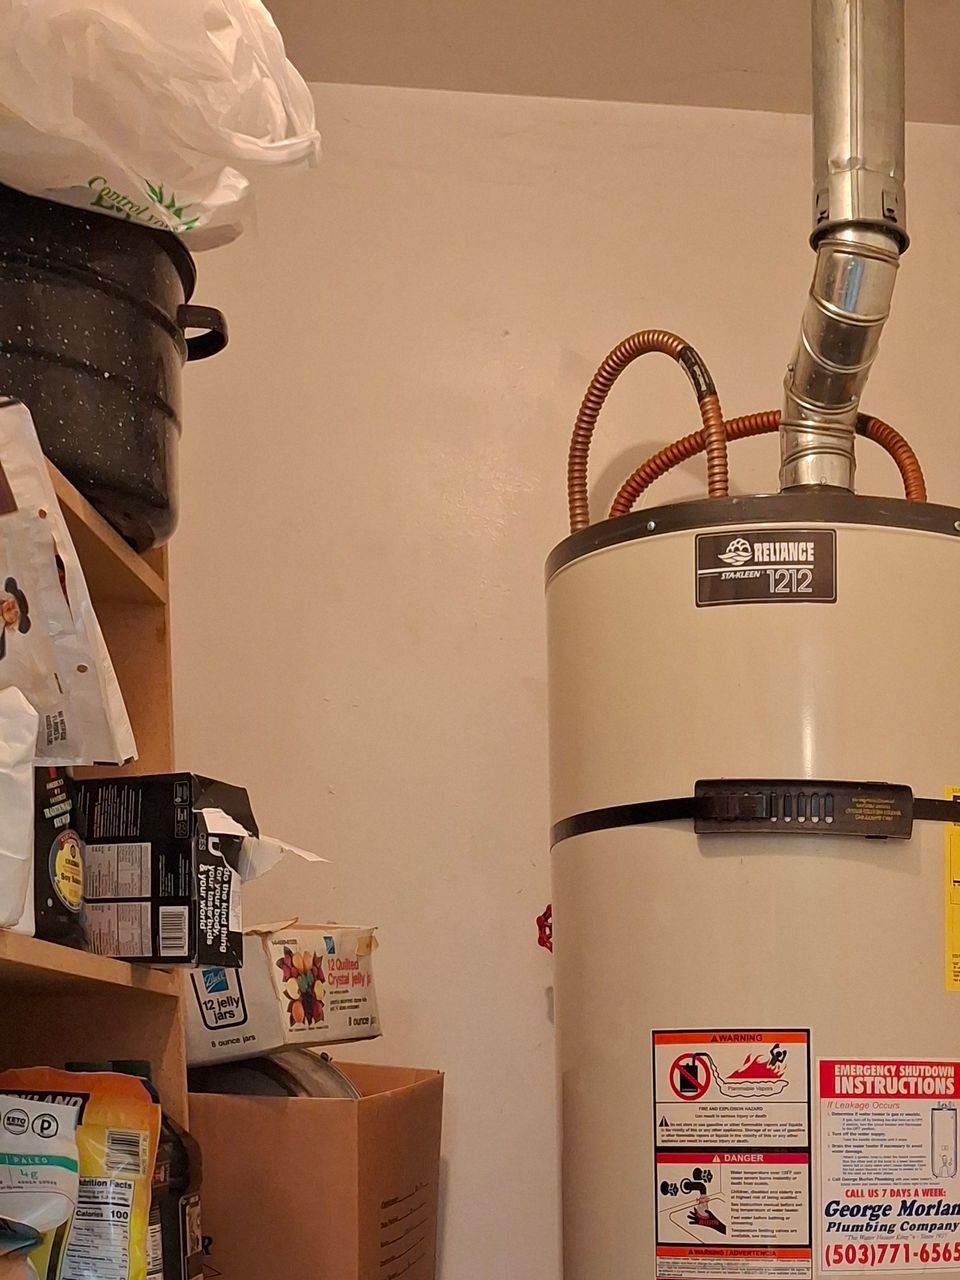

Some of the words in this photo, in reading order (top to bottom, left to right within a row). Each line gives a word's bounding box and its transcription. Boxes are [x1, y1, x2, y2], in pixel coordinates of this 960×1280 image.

[88, 176, 149, 215] Control
[753, 541, 815, 563] RELIANCE
[720, 570, 761, 580] STA-KLEEN
[766, 568, 813, 593] 1212
[199, 863, 208, 872] &
[216, 866, 224, 881] for
[222, 867, 232, 882] do
[208, 865, 216, 889] your
[198, 873, 207, 898] your
[221, 883, 229, 900] the
[214, 883, 222, 906] your
[199, 902, 207, 930] world
[220, 902, 229, 925] kind
[213, 908, 221, 937] body,
[219, 926, 229, 953] thing
[328, 959, 335, 971] 12
[335, 958, 360, 972] Quilted
[328, 972, 350, 986] Crystal
[351, 972, 366, 989] jelly
[202, 999, 216, 1012] 12
[217, 995, 240, 1012] jelly
[213, 1009, 236, 1024] jars
[353, 1016, 369, 1026] ounce
[218, 1038, 241, 1047] ounce
[242, 1035, 256, 1045] jars
[718, 1034, 763, 1043] WARNING
[834, 1065, 897, 1076] EMERGENCY
[900, 1065, 955, 1077] SHUTDOWN
[834, 1076, 955, 1095] INSTRUCTIONS
[827, 1101, 834, 1110] If
[834, 1101, 871, 1111] Leakage
[872, 1101, 901, 1109] Occurs
[7, 1116, 26, 1125] KETO
[13, 1156, 48, 1164] PALEO
[724, 1154, 764, 1162] DANGER
[845, 1188, 865, 1198] CALL
[868, 1188, 879, 1198] US
[881, 1189, 888, 1198] 7
[889, 1189, 911, 1198] DAYS
[913, 1189, 920, 1197] A
[921, 1188, 946, 1198] WEEK:
[75, 1209, 104, 1218] Calories
[110, 1209, 129, 1220] 100
[825, 1200, 893, 1221] George
[826, 1221, 897, 1234] Plumbing
[900, 1220, 960, 1233] Company
